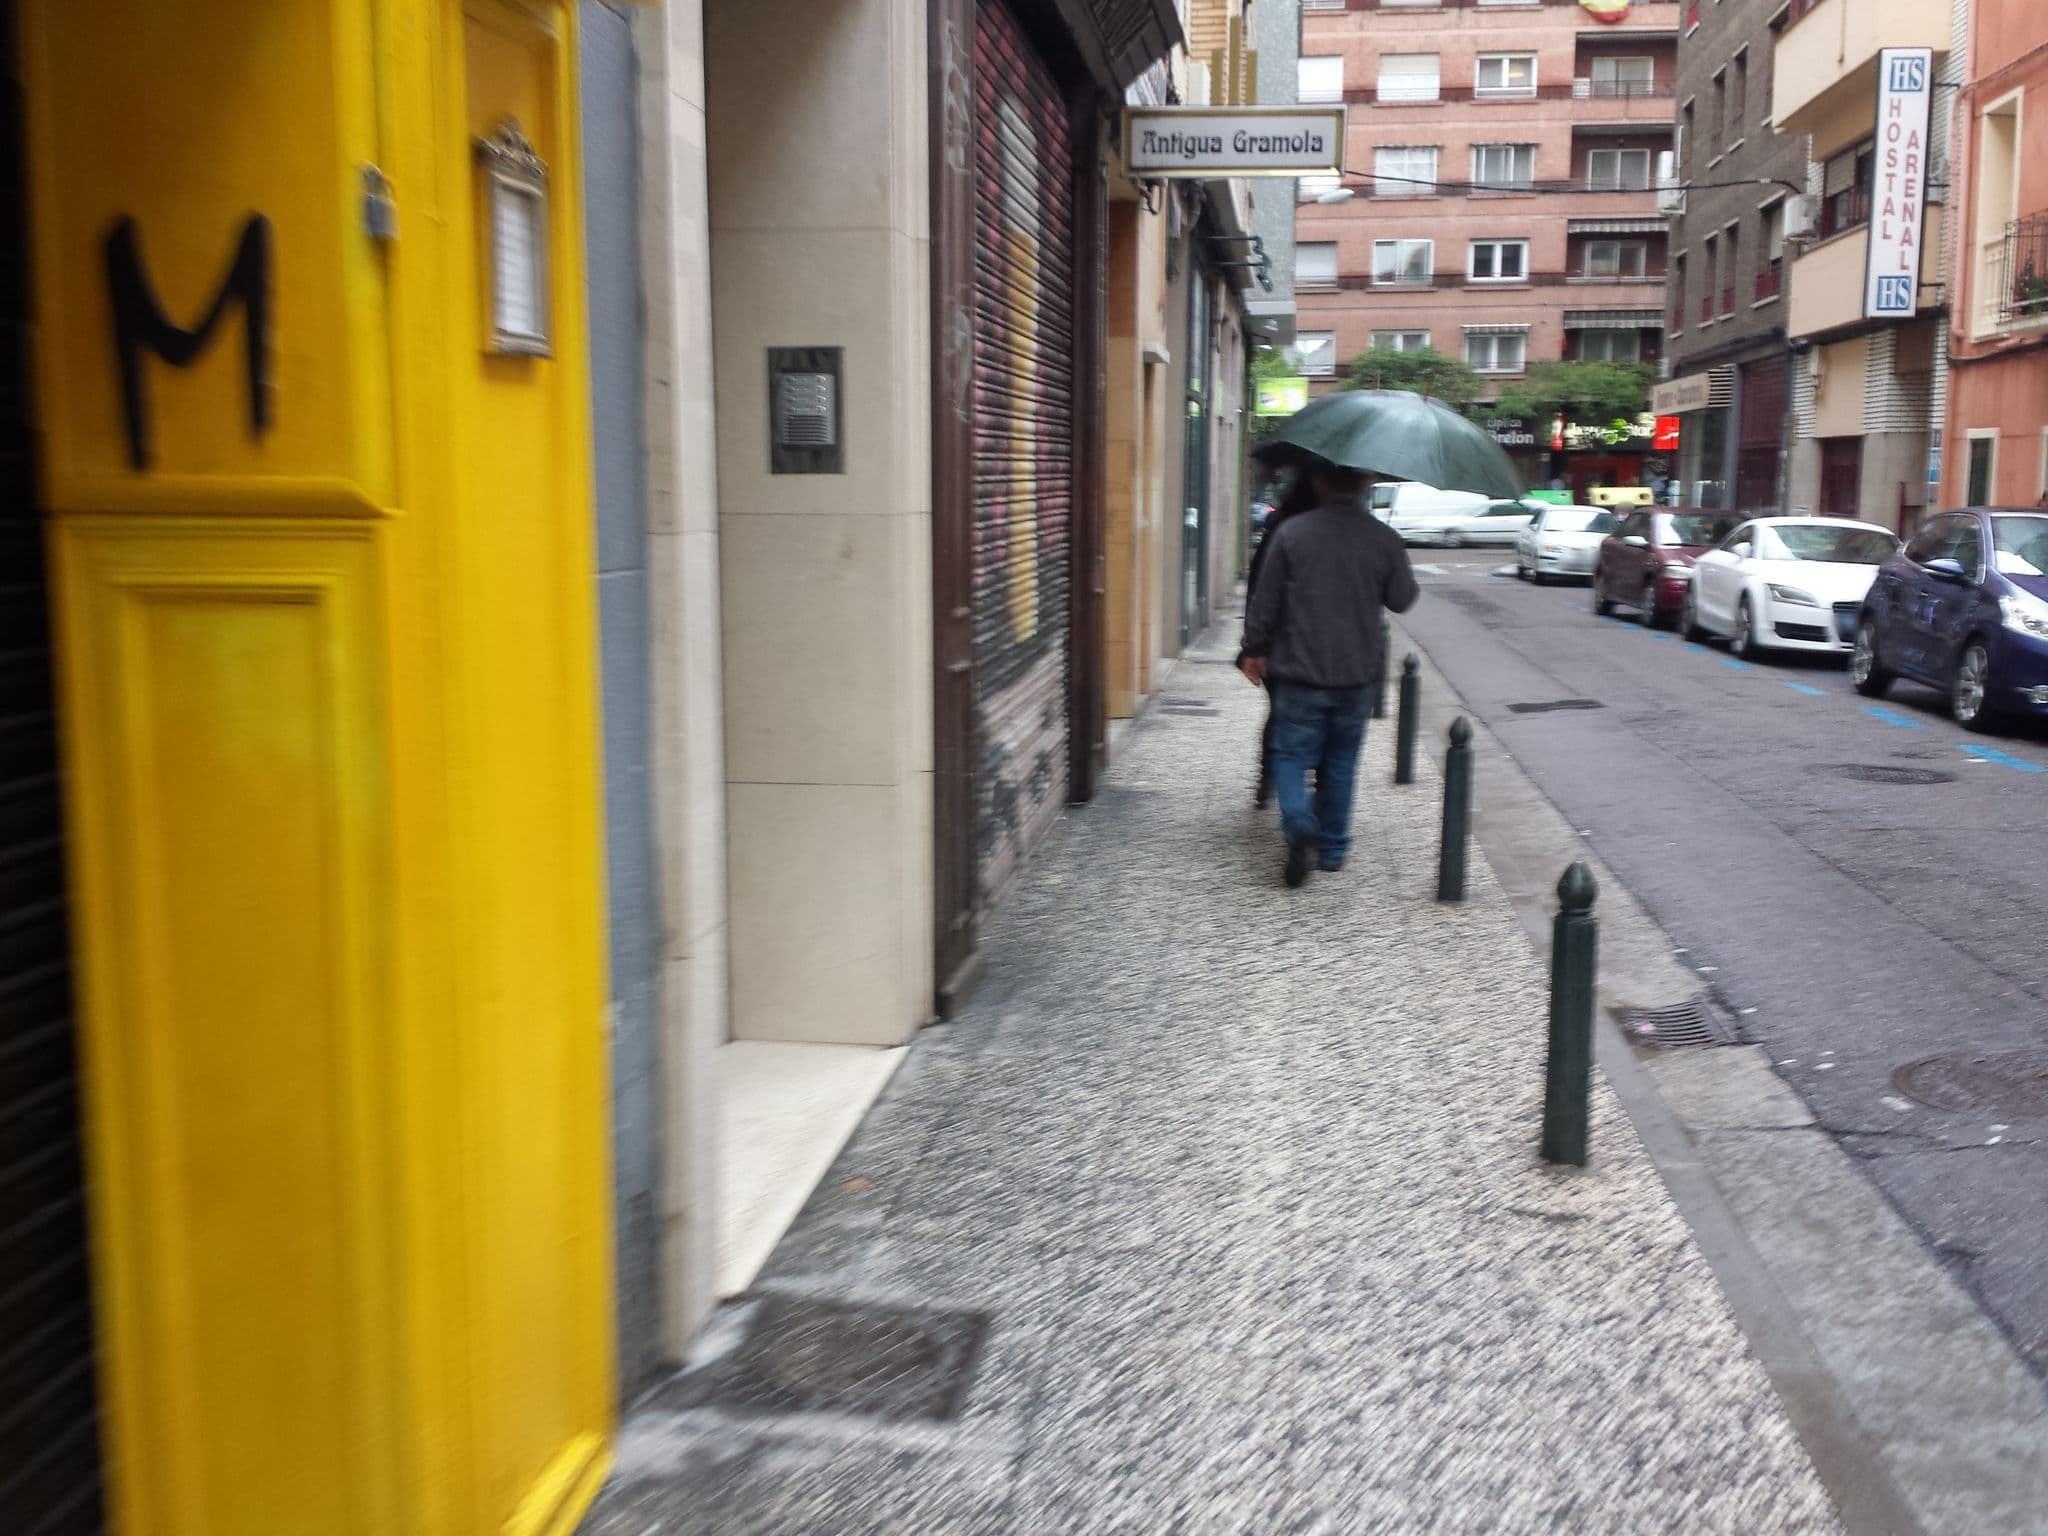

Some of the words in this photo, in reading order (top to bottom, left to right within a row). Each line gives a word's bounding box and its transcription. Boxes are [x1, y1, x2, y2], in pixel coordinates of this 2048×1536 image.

[1142, 129, 1224, 160] Antigua
[1232, 129, 1323, 153] Gramola
[1881, 98, 1902, 240] HOSTAL
[1899, 129, 1920, 271] ARENAL
[103, 211, 273, 472] M
